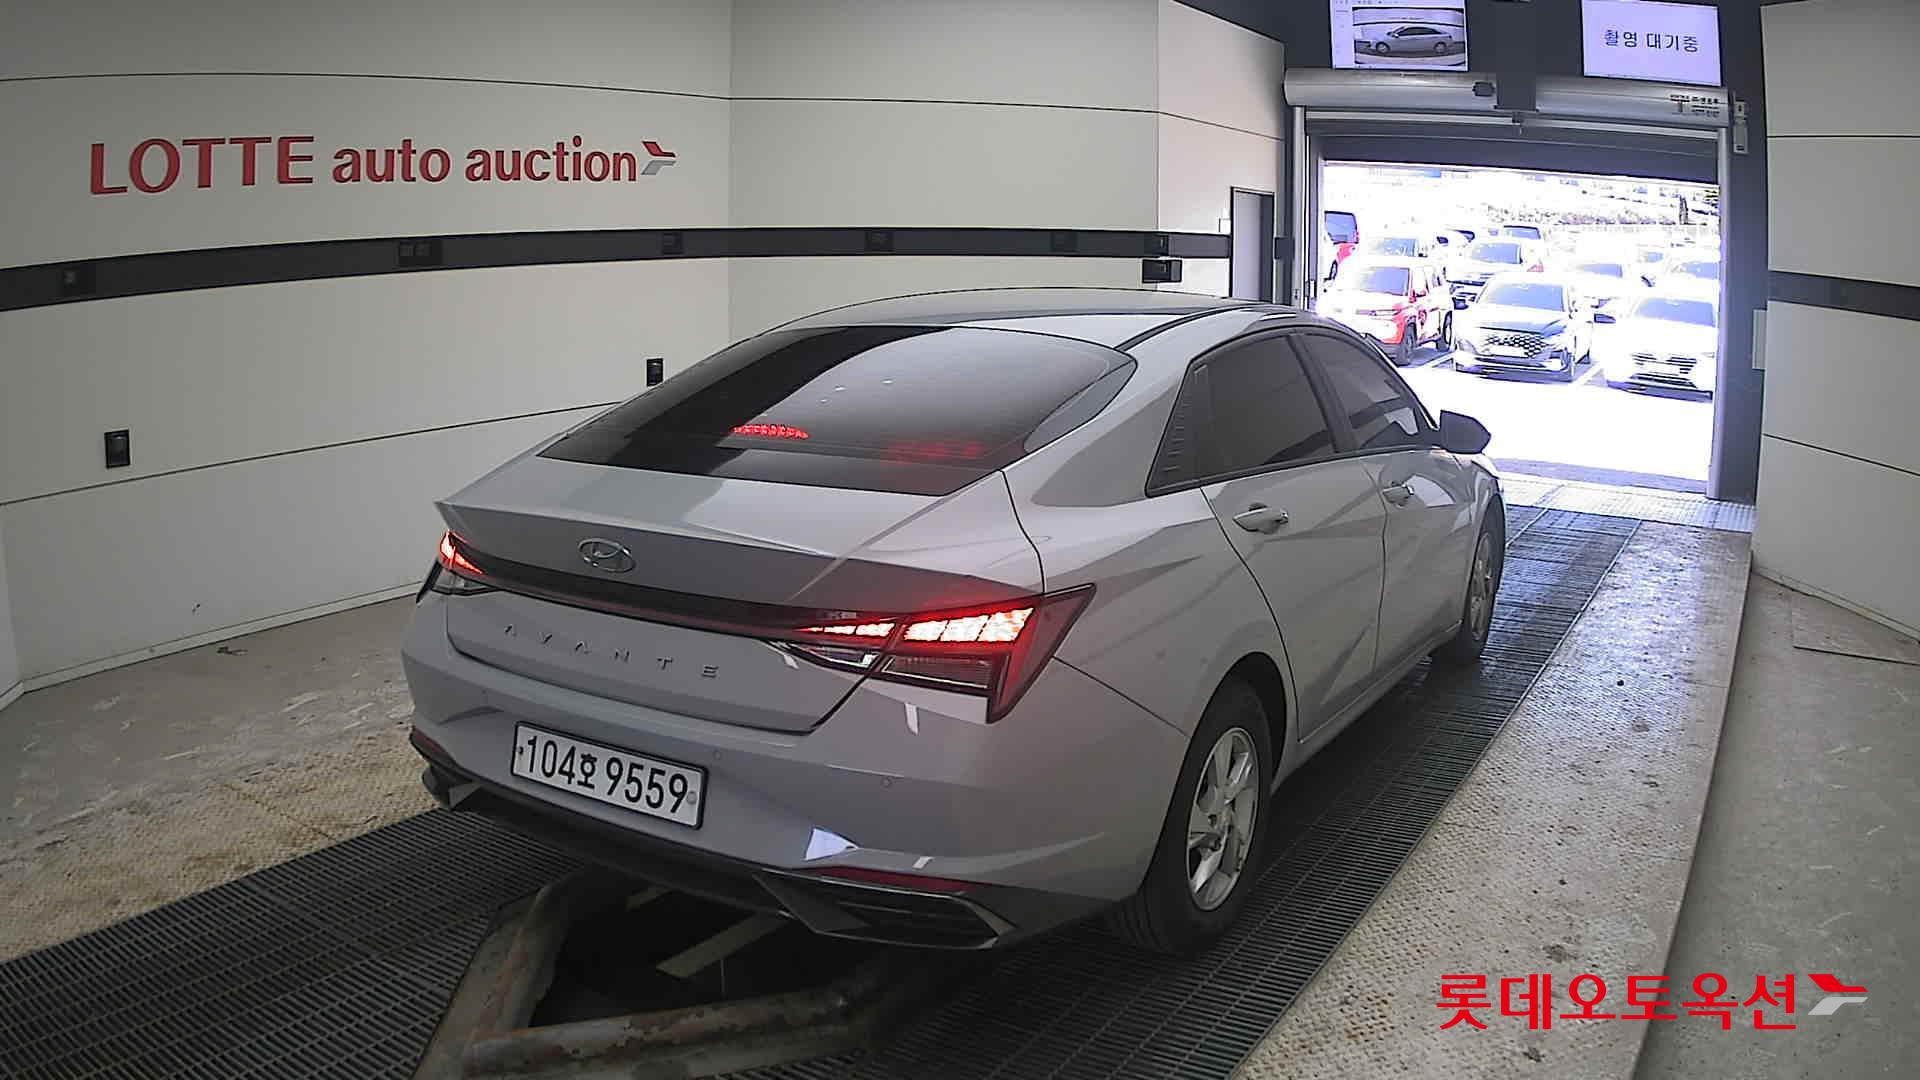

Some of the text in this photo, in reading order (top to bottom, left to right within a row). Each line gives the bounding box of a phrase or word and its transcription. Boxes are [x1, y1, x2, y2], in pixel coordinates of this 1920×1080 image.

[1605, 29, 1698, 53] 촬영 대기중
[90, 135, 637, 195] LOTTE auto auction
[503, 623, 719, 679] AVANTE
[527, 736, 689, 814] 104호 9559
